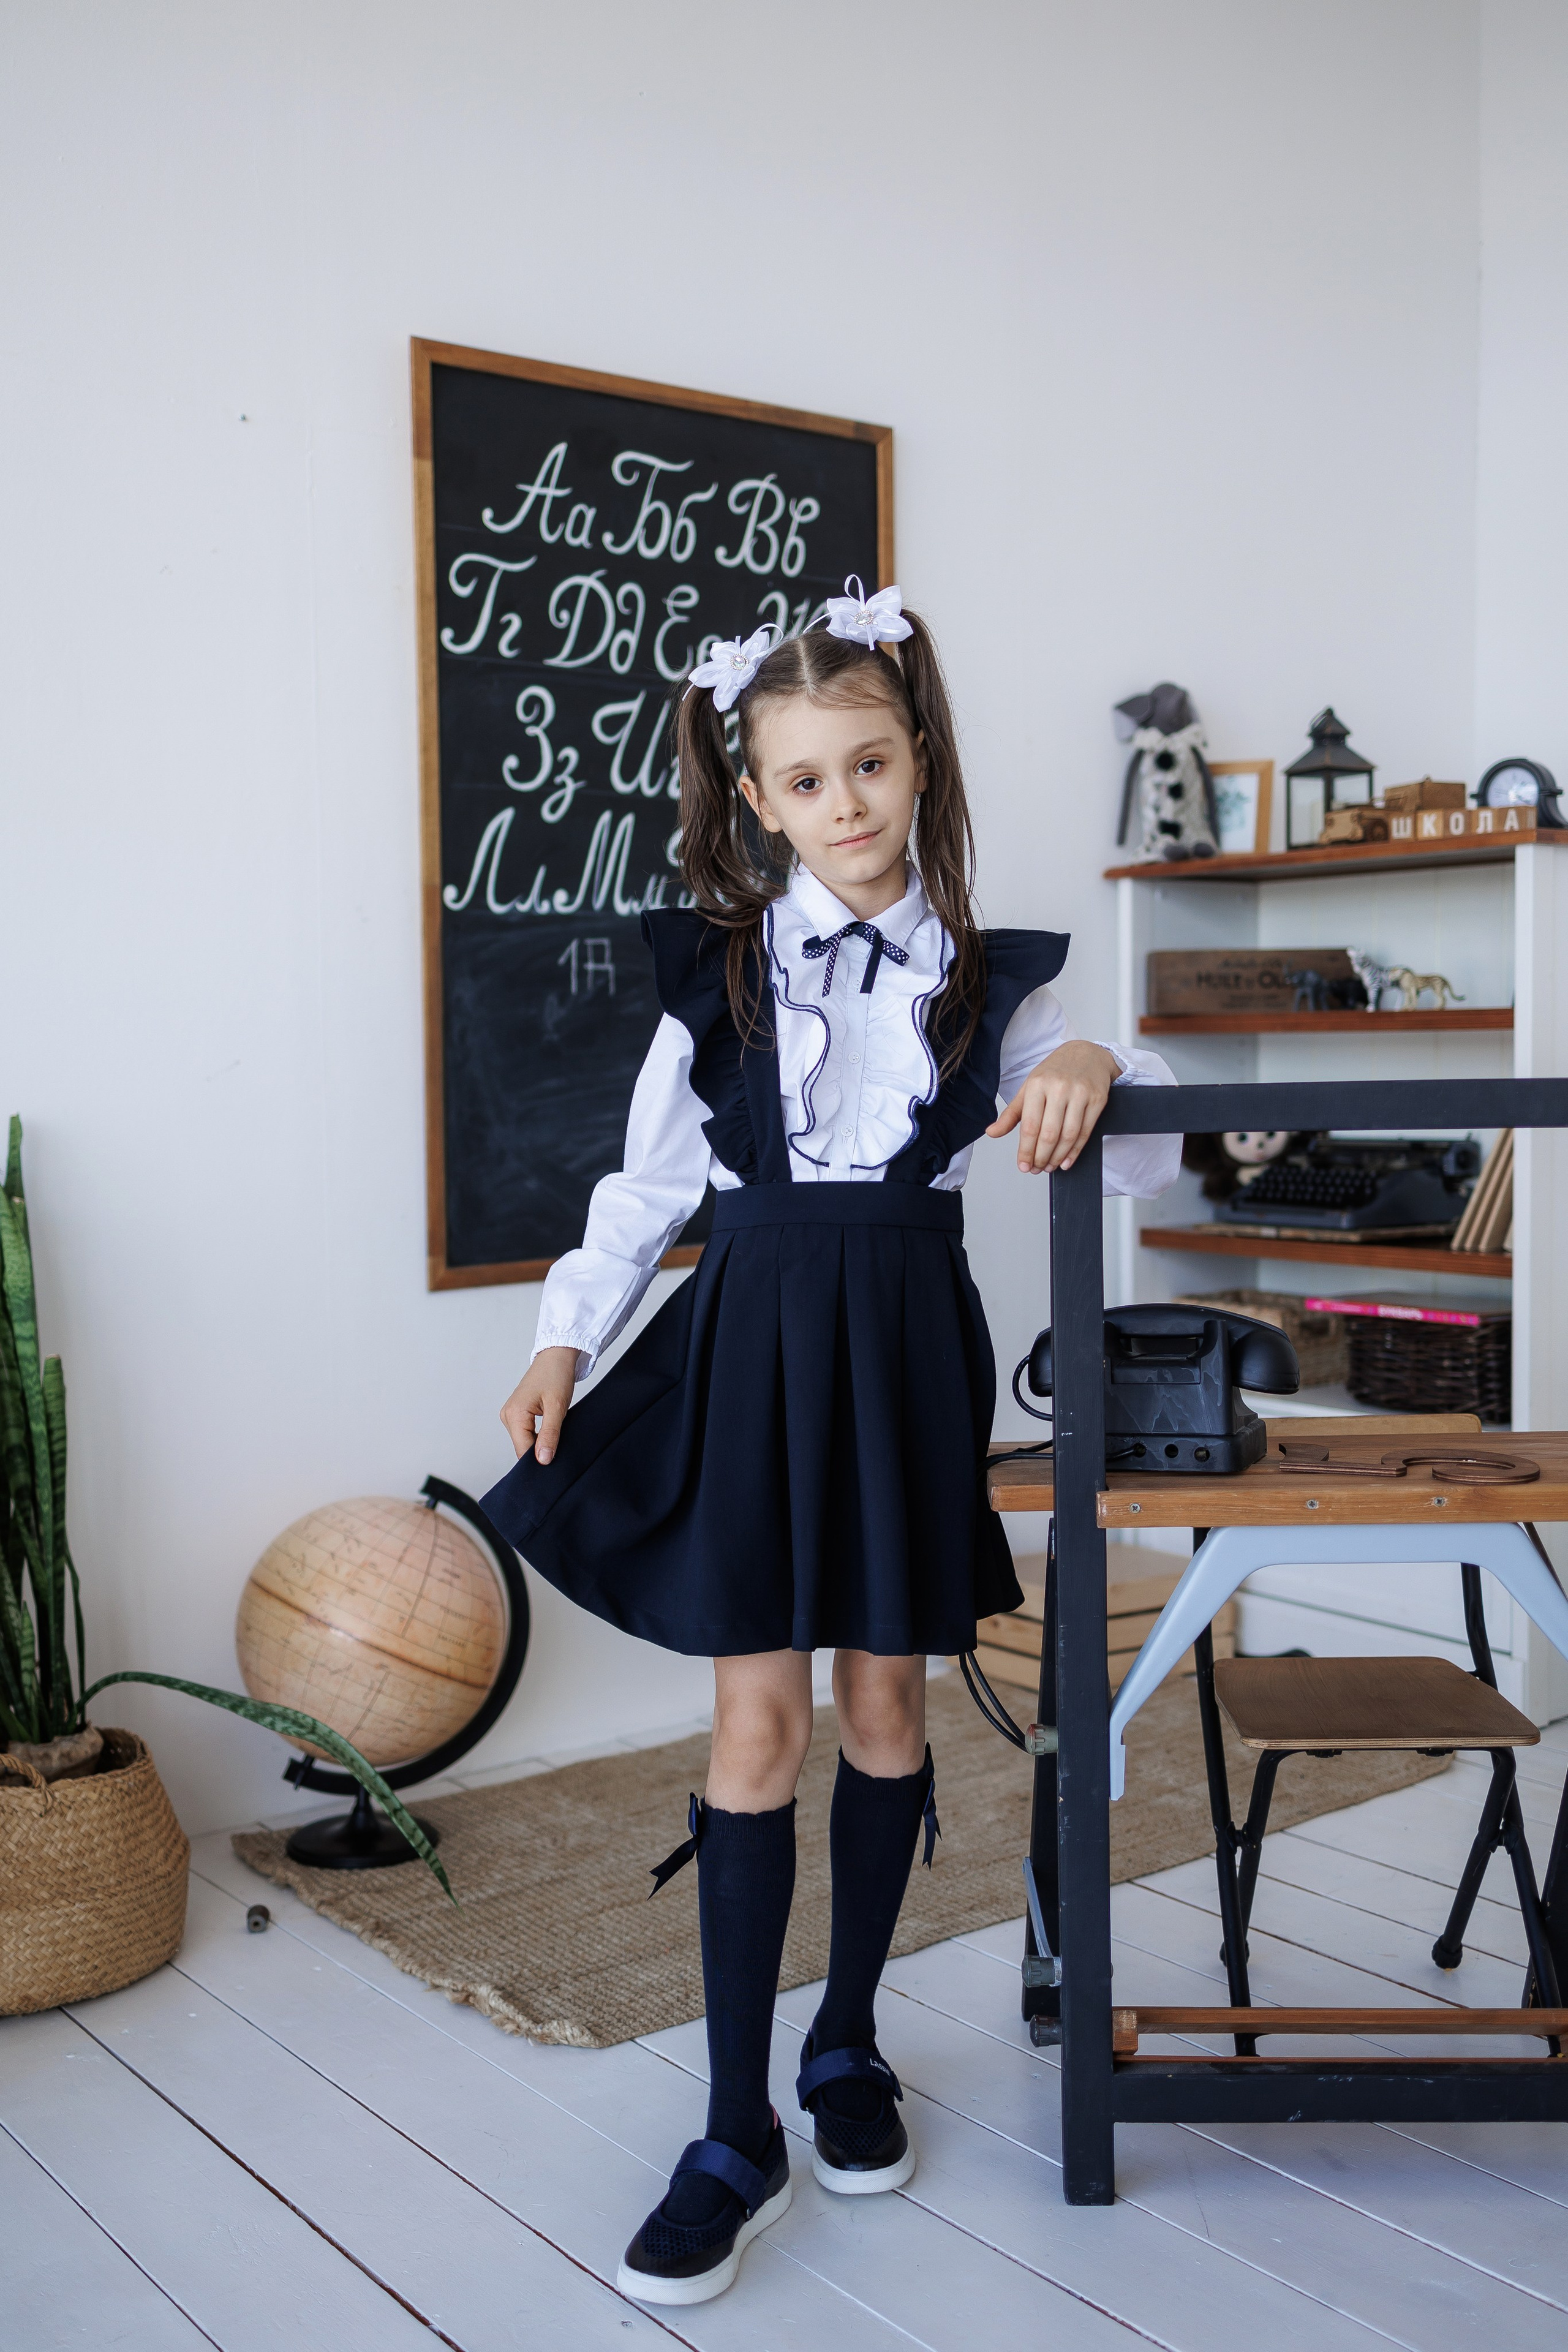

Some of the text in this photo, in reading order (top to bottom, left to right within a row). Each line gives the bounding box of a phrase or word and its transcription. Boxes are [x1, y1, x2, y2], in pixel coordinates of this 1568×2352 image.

[481, 442, 821, 578] Аа Бб Вв
[440, 552, 538, 659] Гг
[543, 568, 646, 675] Дд
[502, 685, 586, 824] Зз
[591, 690, 682, 801] И
[442, 806, 549, 915] Лл
[1391, 809, 1520, 840] ШКОЛА
